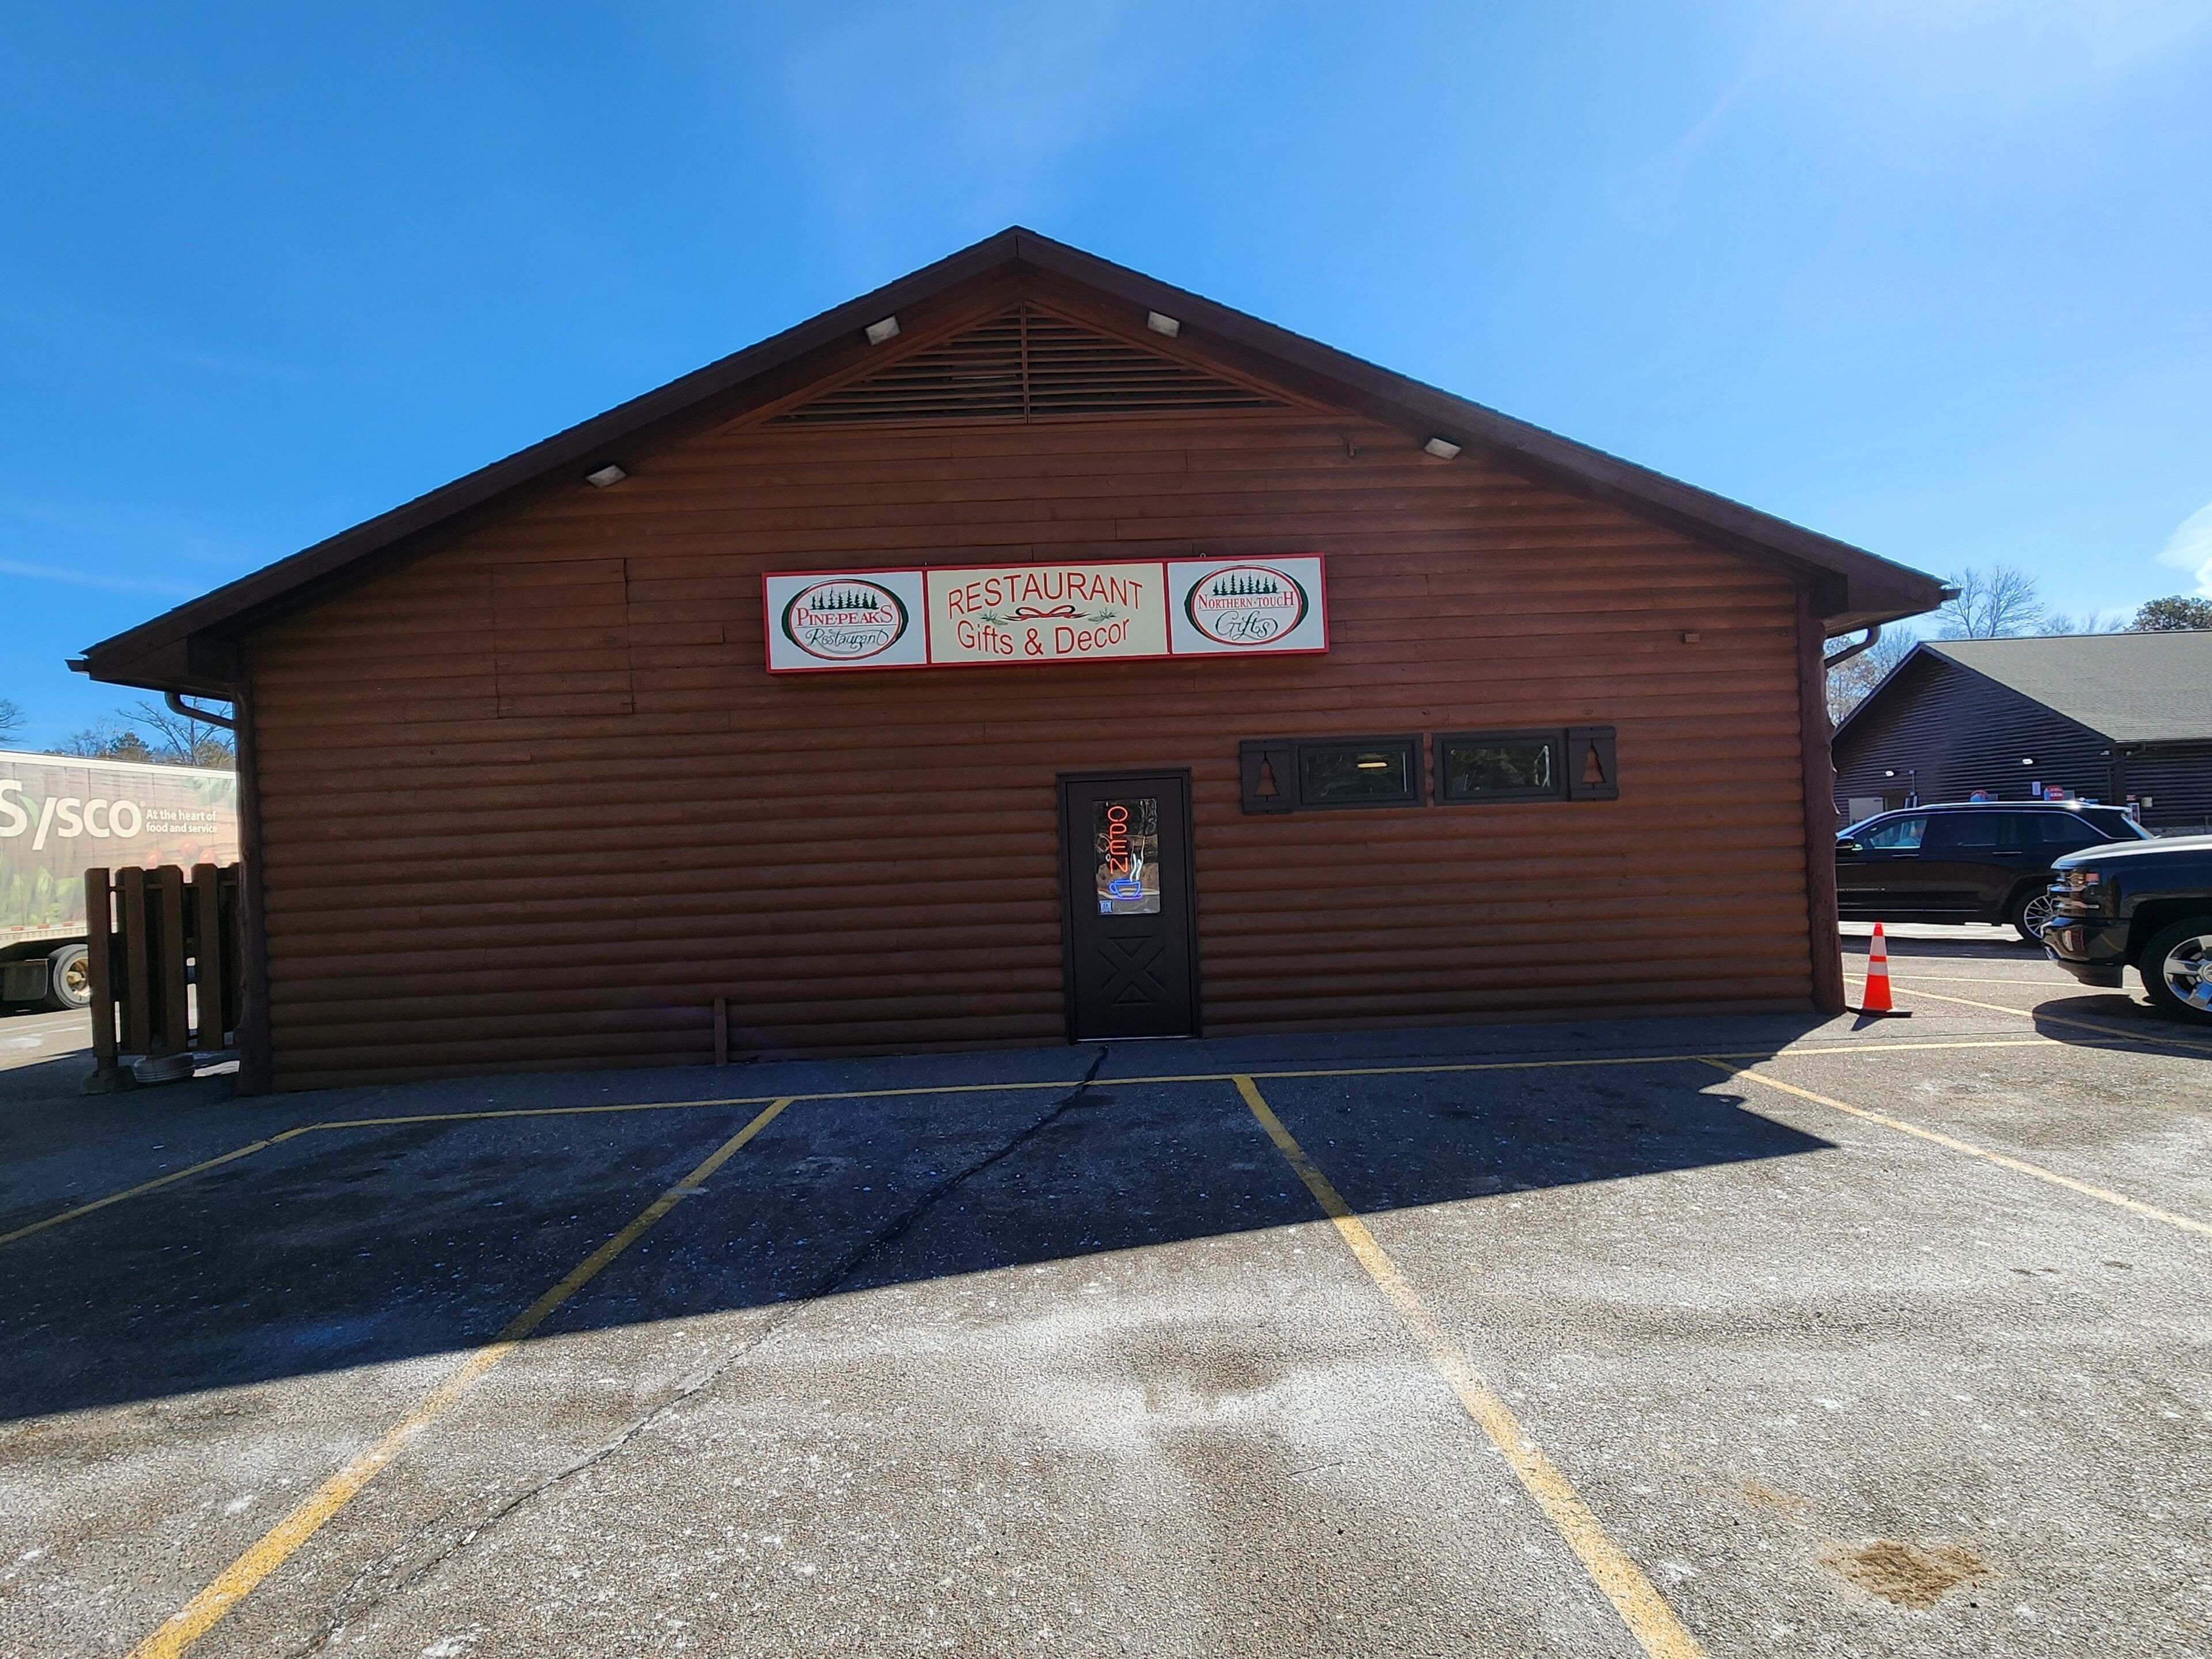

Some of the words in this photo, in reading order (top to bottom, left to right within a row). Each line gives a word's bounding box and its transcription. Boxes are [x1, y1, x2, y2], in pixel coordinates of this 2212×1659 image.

[948, 572, 1143, 619] RESTAURANT
[805, 628, 889, 654] Restaurant
[957, 620, 1013, 655] Gifts
[1024, 628, 1044, 656] &
[1055, 619, 1130, 654] Decor
[1215, 610, 1278, 641] Gifts
[146, 809, 158, 820] At
[160, 809, 176, 820] the
[179, 809, 204, 821] heart
[206, 810, 217, 821] of
[146, 822, 168, 832] food
[169, 823, 187, 833] and
[188, 824, 218, 833] service
[1108, 806, 1128, 875] OPEN
